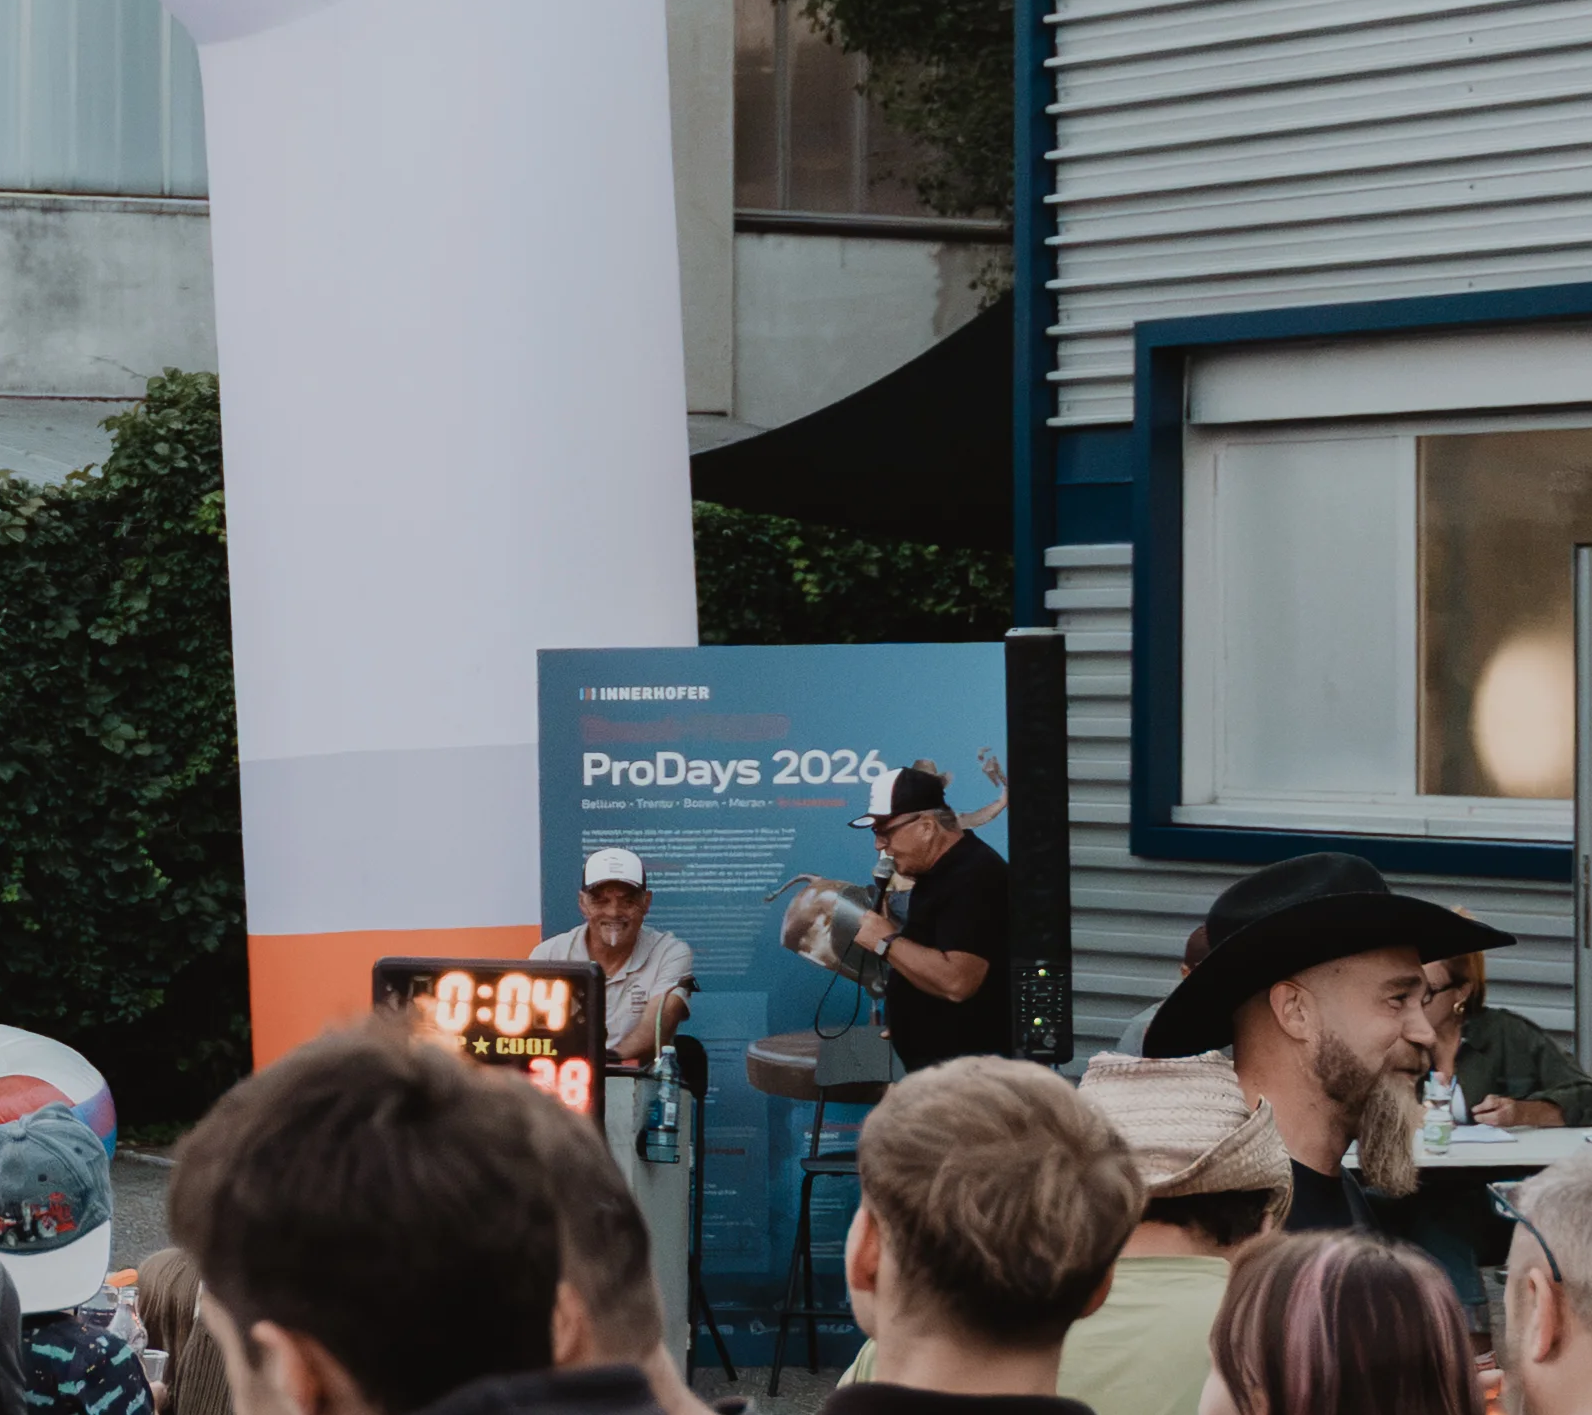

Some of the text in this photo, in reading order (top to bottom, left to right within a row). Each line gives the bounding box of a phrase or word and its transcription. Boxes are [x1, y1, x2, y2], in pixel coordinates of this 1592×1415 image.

[600, 686, 711, 701] INNERHOFER
[582, 749, 889, 793] ProDays 2026
[435, 971, 569, 1035] 0:04
[495, 1037, 558, 1056] COOL
